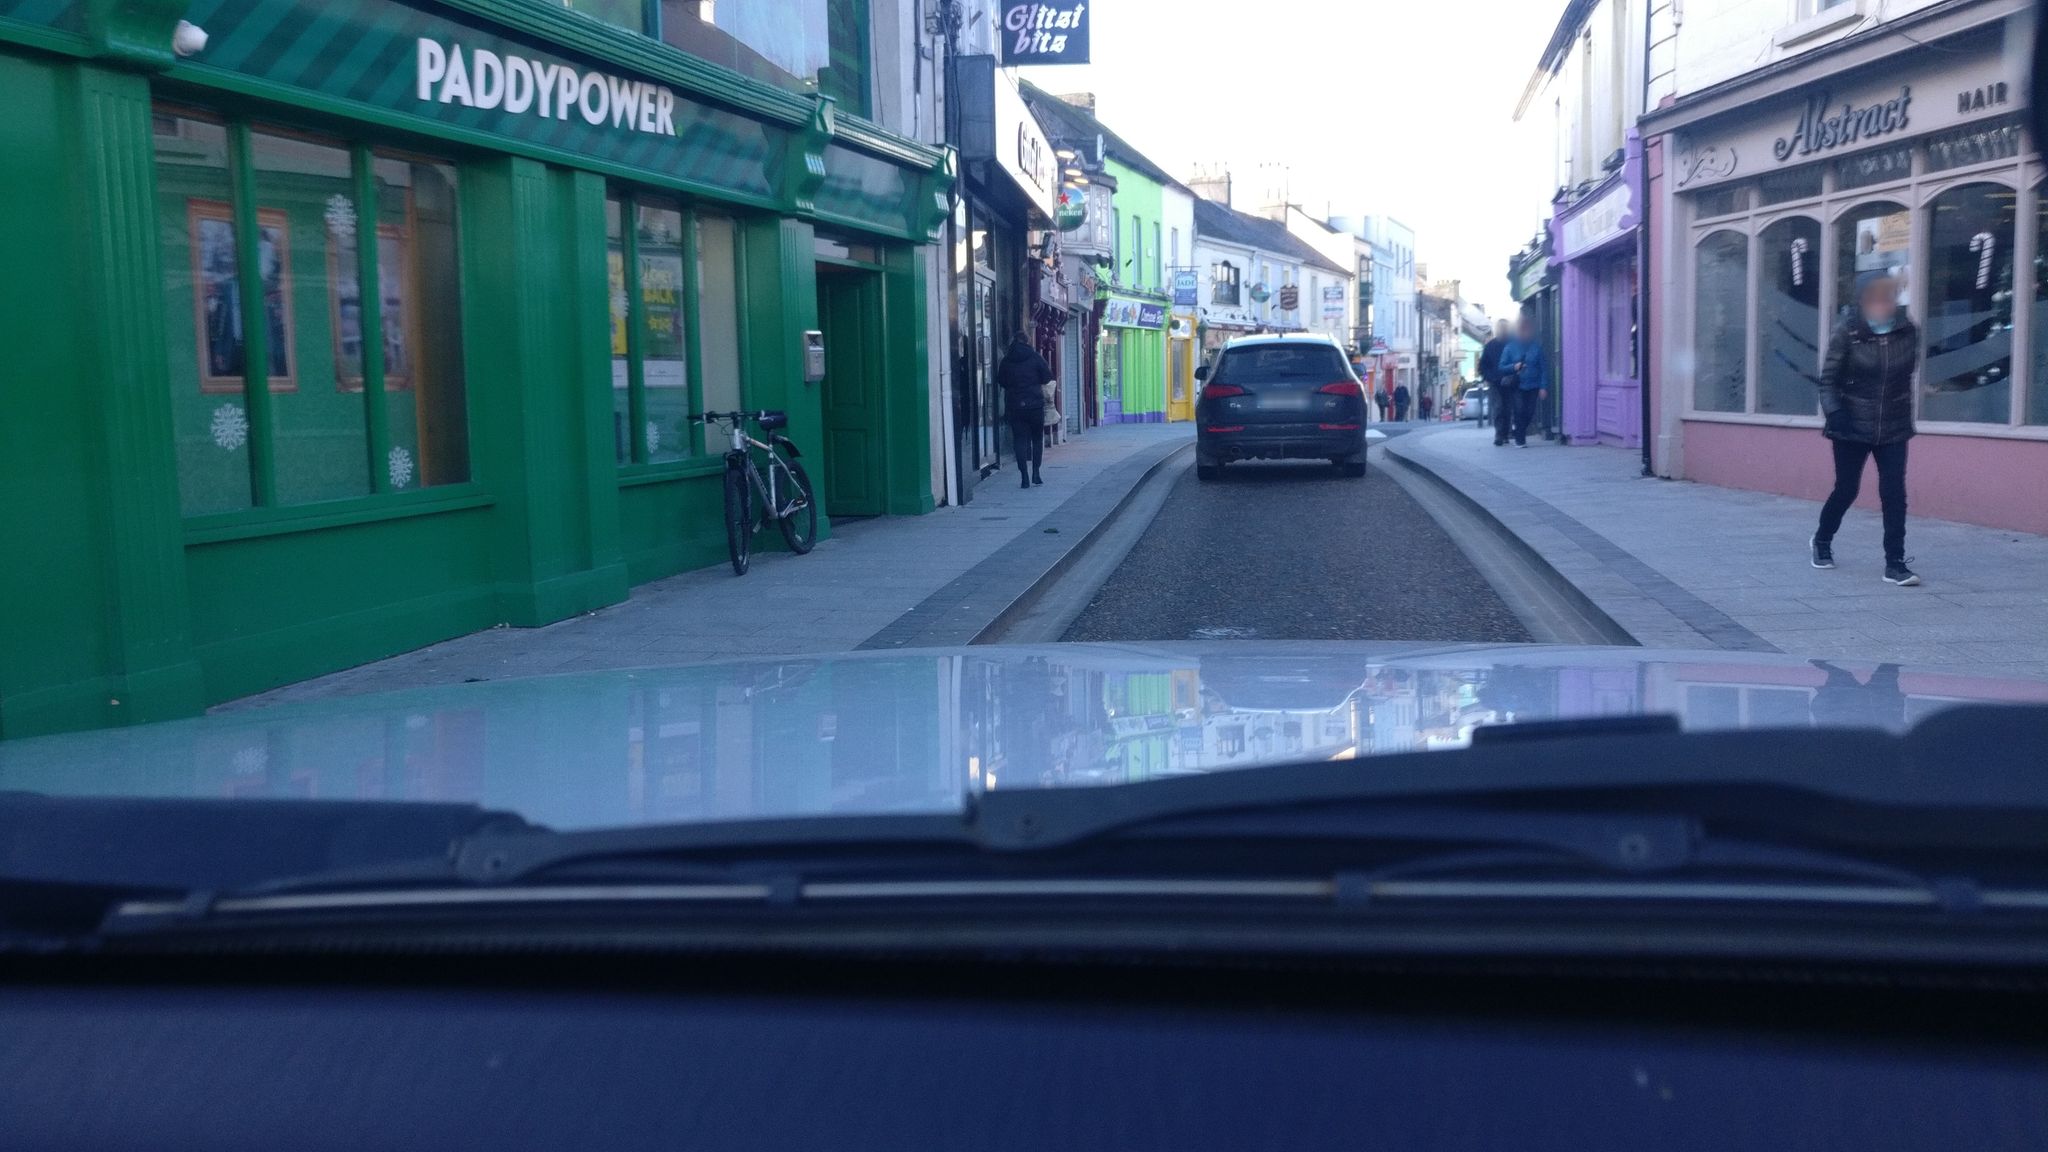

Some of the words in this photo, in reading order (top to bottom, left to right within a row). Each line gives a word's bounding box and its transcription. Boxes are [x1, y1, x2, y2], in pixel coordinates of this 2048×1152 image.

[1005, 3, 1086, 31] Glitzi
[1013, 27, 1068, 55] bitz
[1957, 81, 2009, 115] HAIR
[1773, 86, 1912, 160] Abstract
